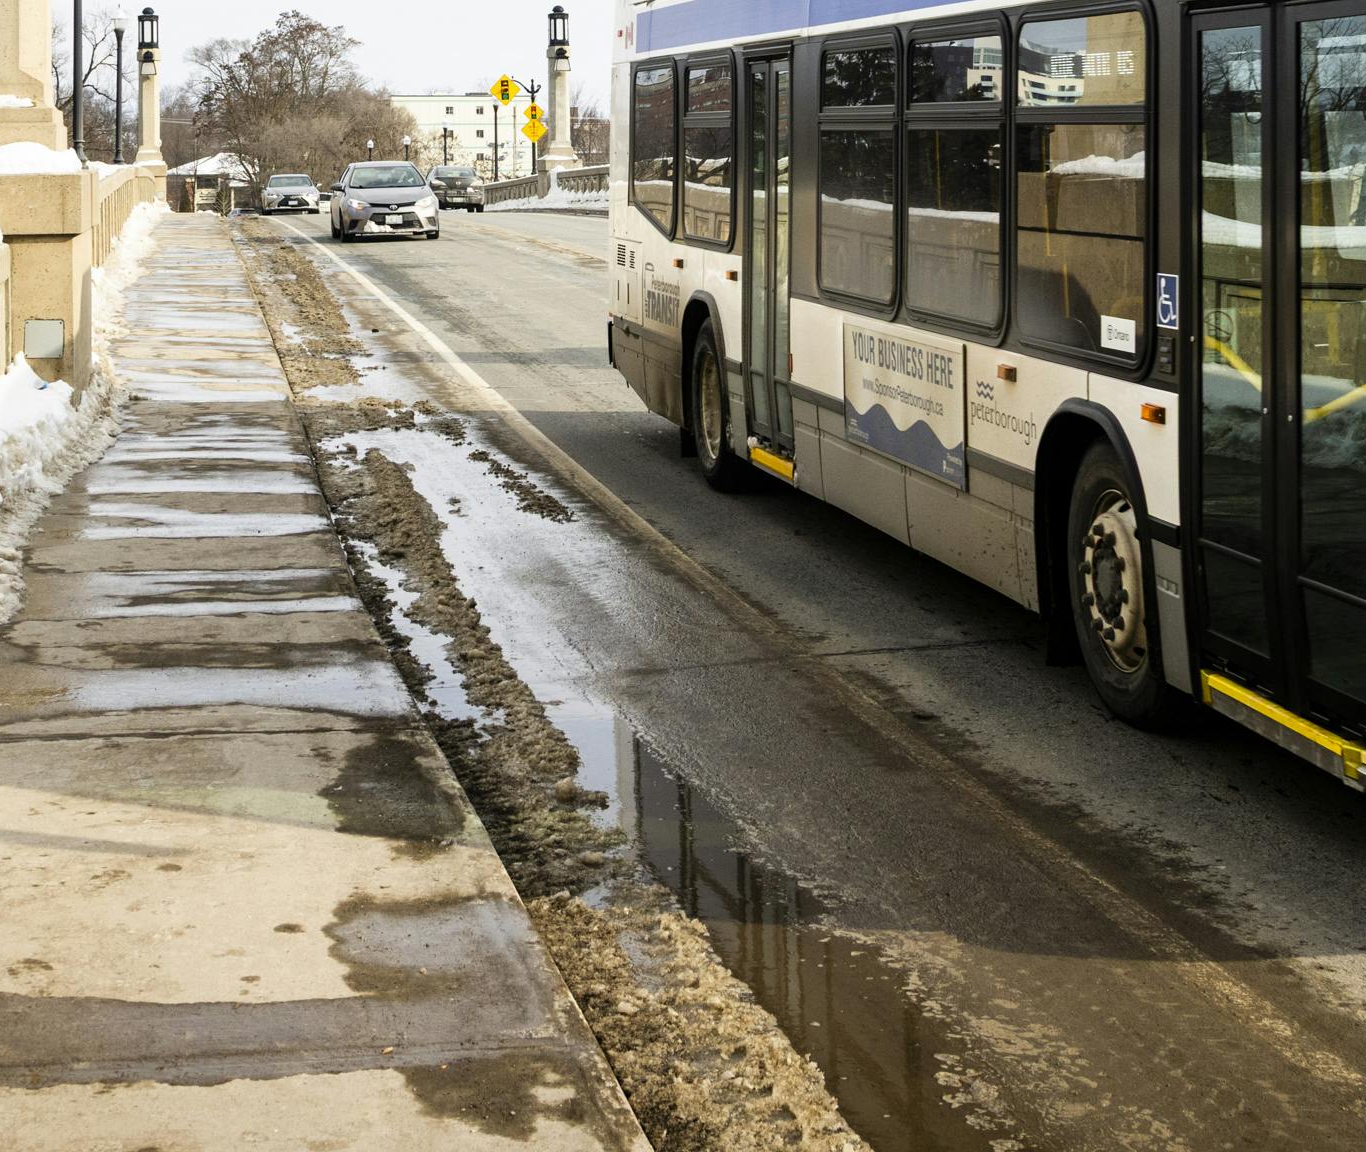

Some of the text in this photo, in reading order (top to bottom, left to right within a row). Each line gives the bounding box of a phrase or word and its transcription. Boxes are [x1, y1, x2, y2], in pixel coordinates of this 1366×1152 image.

[646, 289, 680, 327] TRANSIT
[852, 331, 954, 389] YOUR BUSINESS HERE
[970, 400, 1037, 446] peterborough
